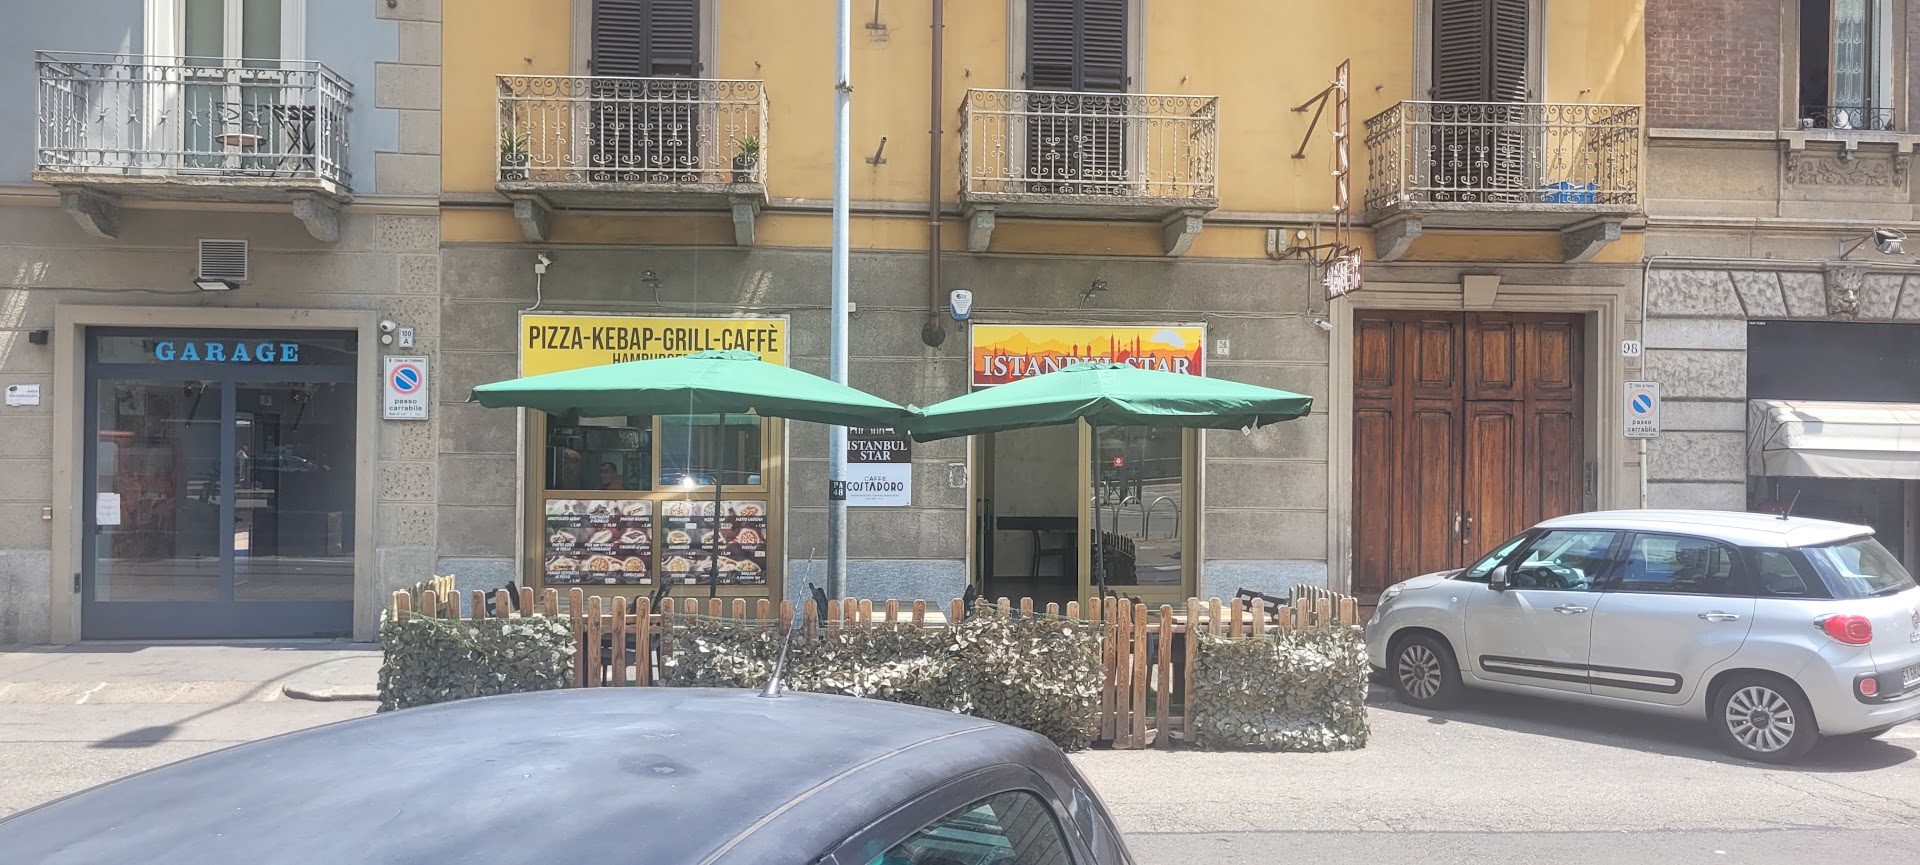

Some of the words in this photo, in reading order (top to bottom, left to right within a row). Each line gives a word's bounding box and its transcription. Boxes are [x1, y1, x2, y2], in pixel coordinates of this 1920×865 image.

[402, 330, 412, 338] 100
[529, 324, 778, 353] PIZZA-KEBAP-GRILL-CAFFÈ
[155, 342, 299, 362] GARAGE
[1623, 343, 1638, 354] 98
[1124, 356, 1190, 375] STAR
[847, 440, 908, 451] ISTANBUL
[860, 451, 891, 461] STAR
[833, 481, 843, 489] PA
[847, 481, 904, 492] COSTADORO
[833, 488, 844, 497] 48
